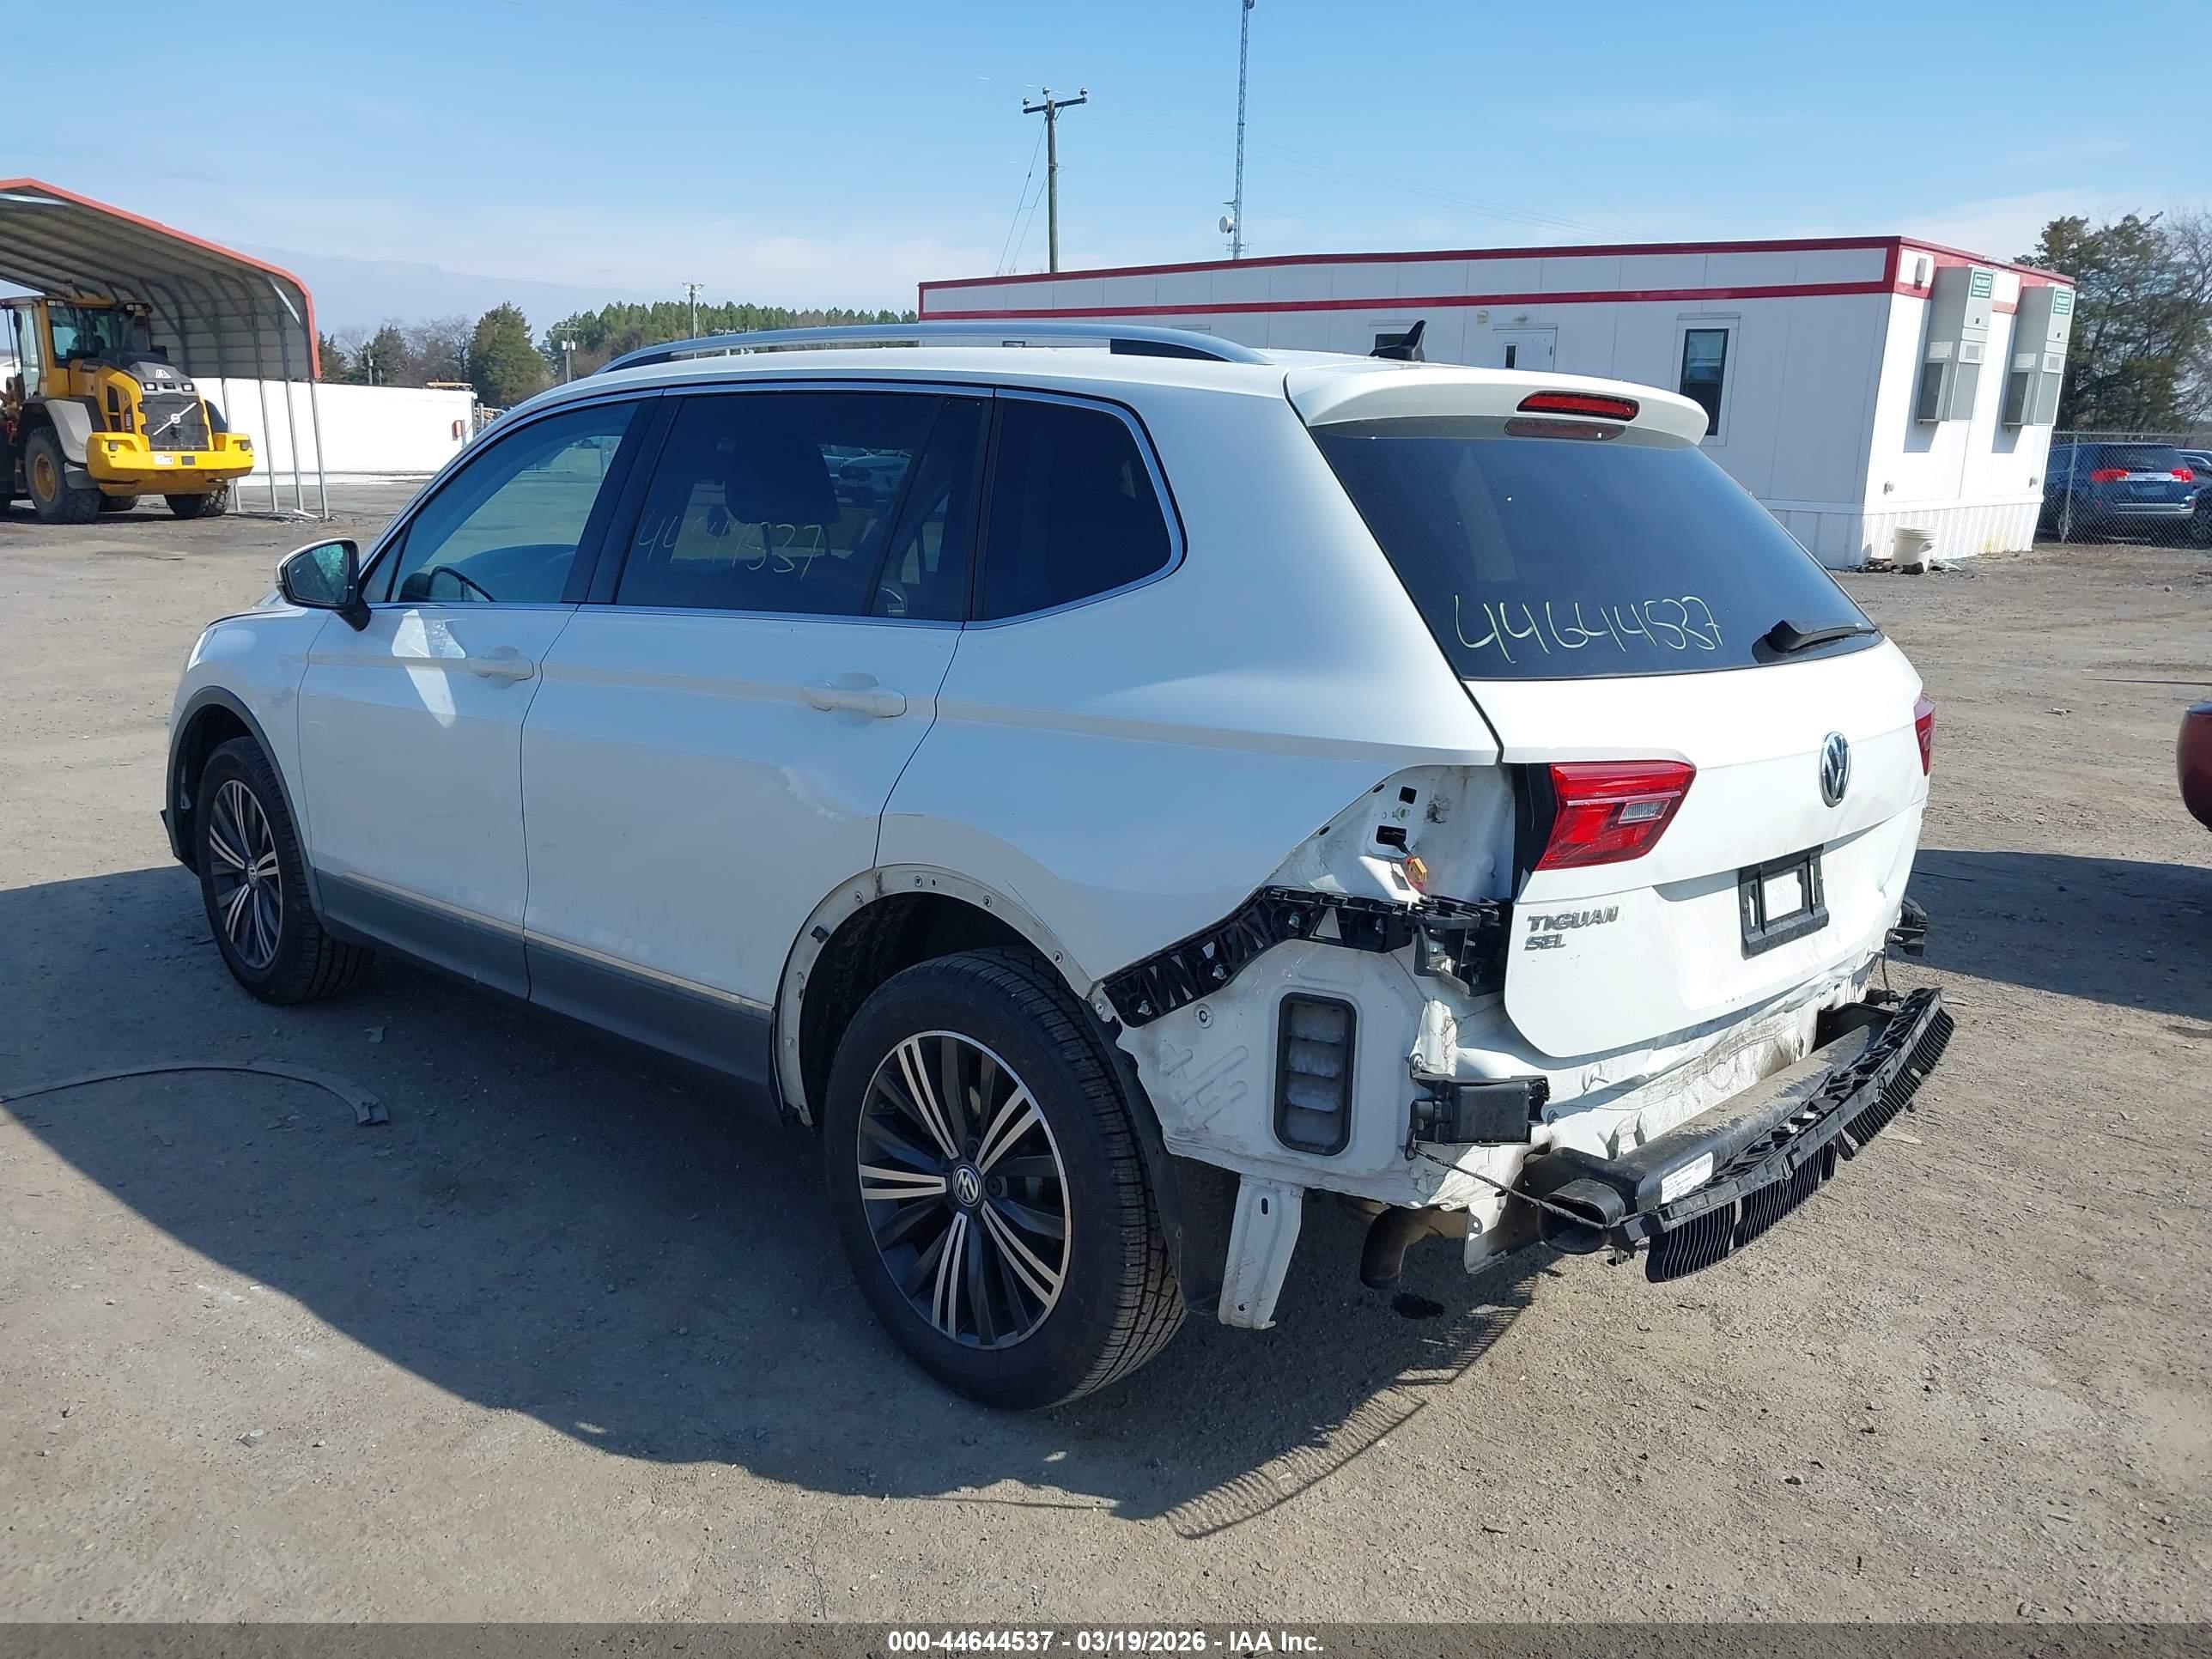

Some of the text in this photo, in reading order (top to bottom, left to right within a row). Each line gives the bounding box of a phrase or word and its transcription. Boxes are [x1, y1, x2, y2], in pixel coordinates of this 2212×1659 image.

[1455, 593, 1723, 664] 44644537
[1526, 906, 1620, 933] TIGUAN
[1523, 933, 1567, 951] SEL
